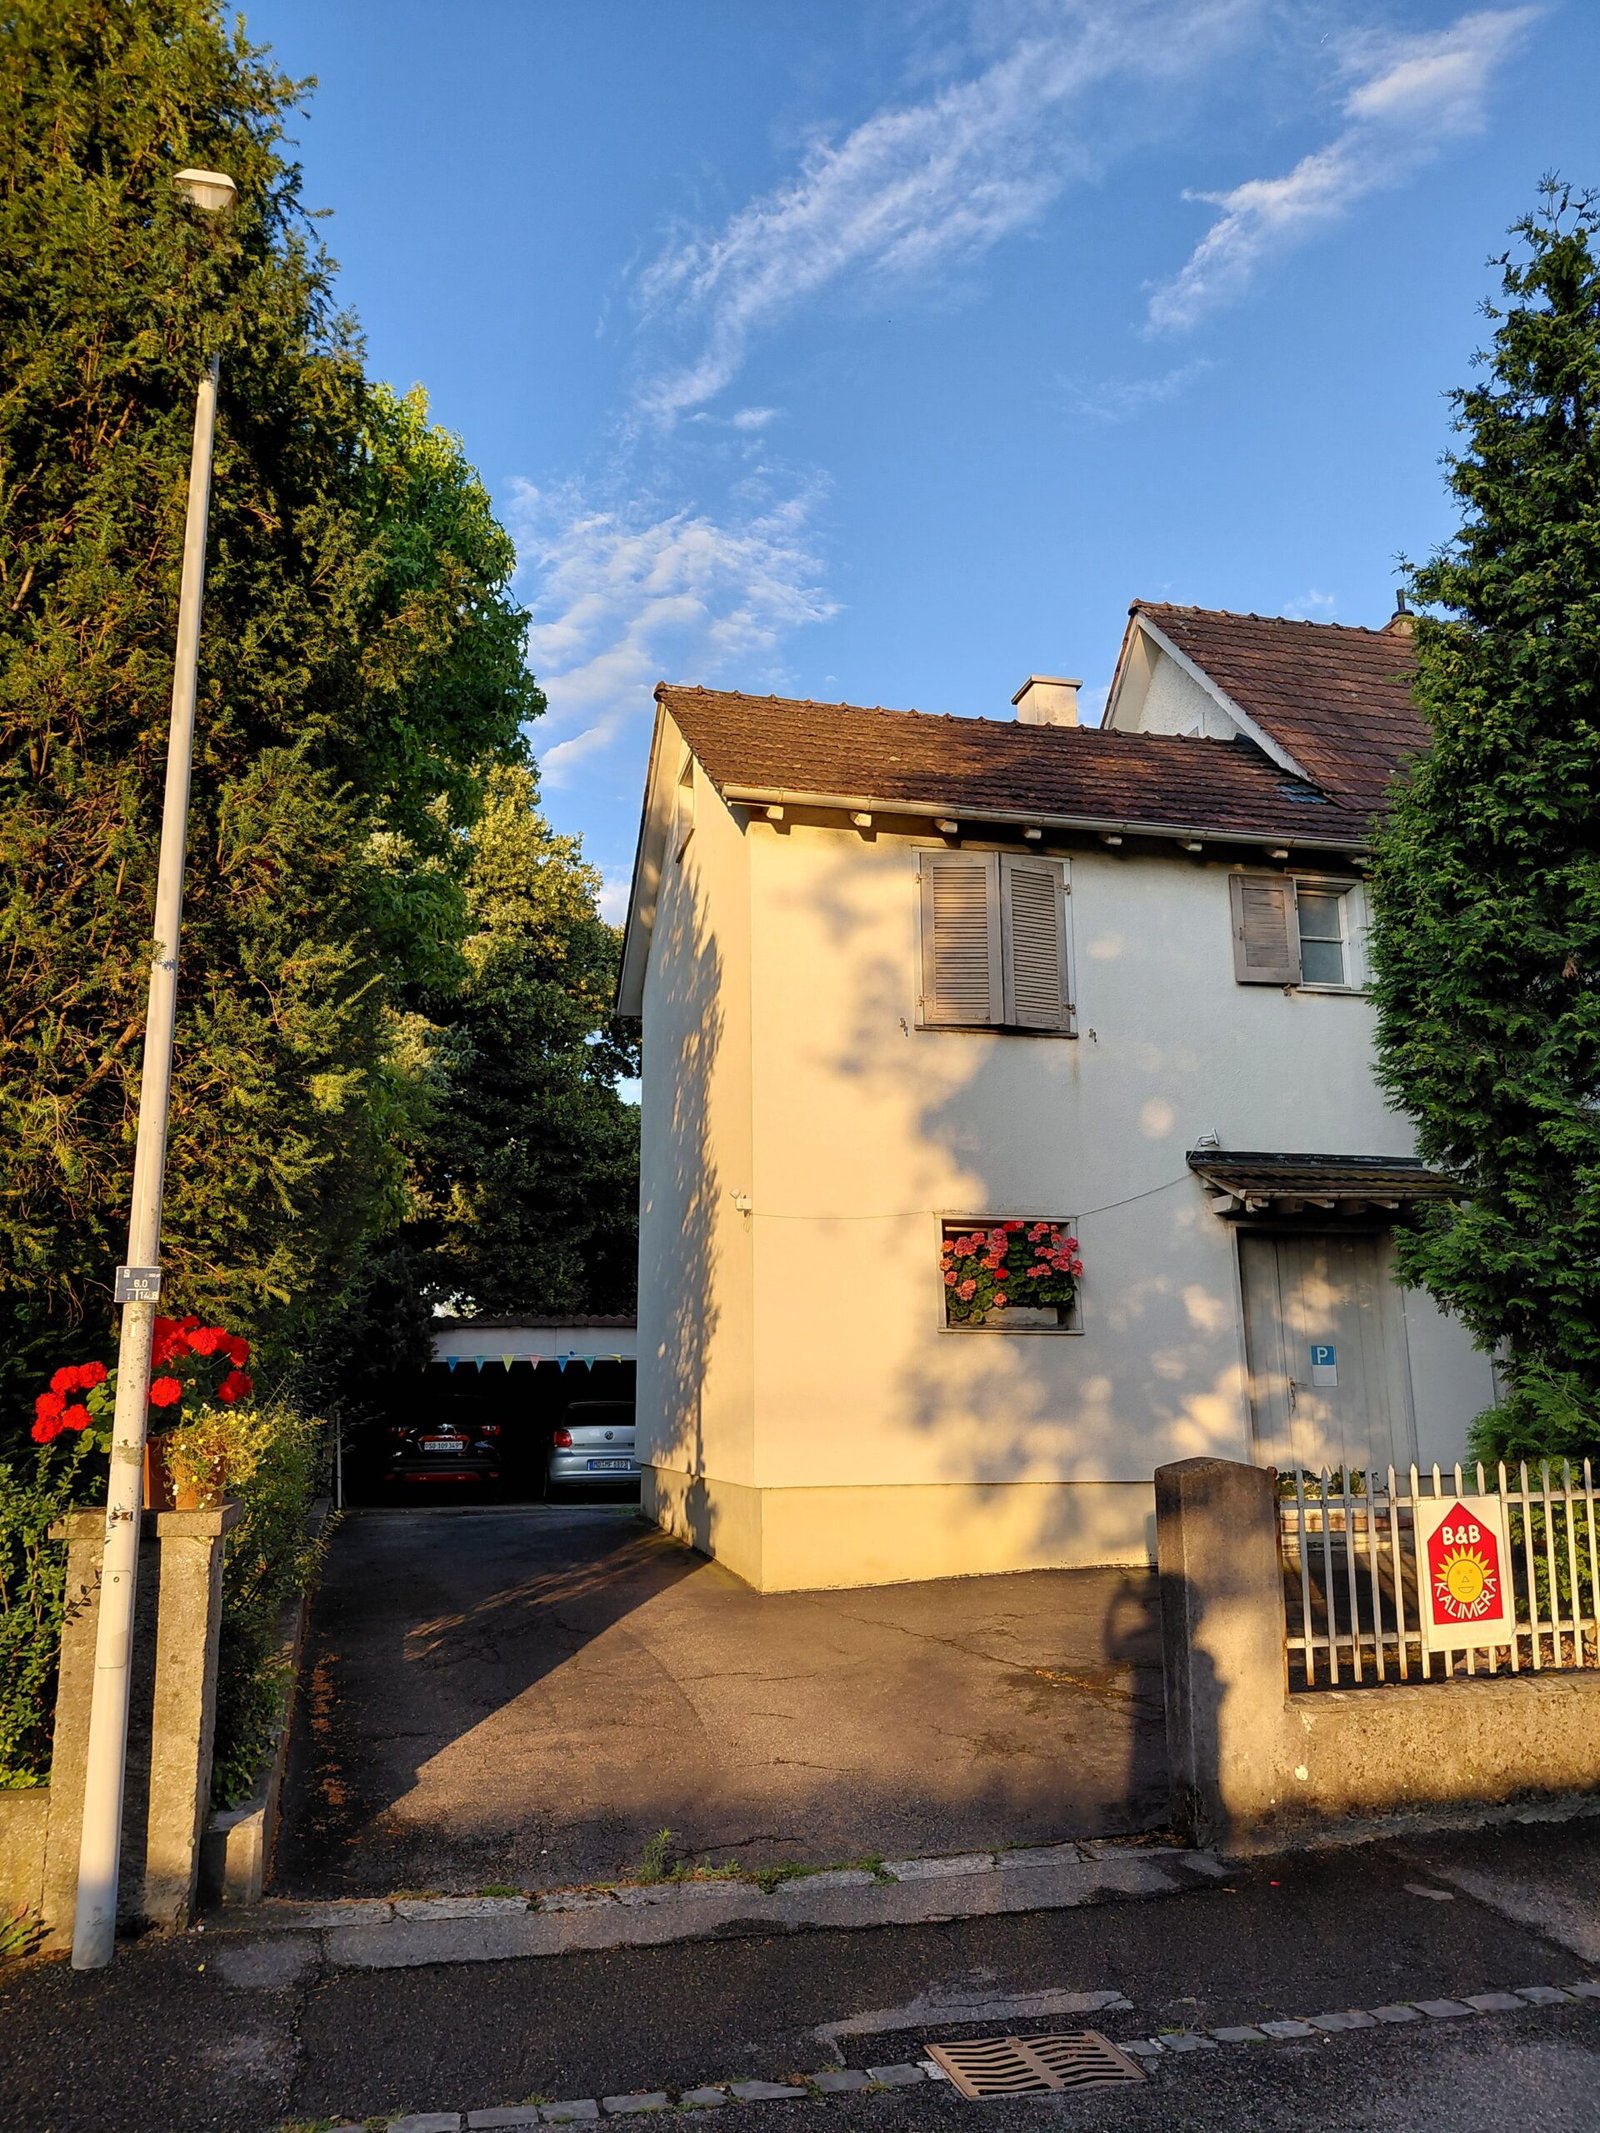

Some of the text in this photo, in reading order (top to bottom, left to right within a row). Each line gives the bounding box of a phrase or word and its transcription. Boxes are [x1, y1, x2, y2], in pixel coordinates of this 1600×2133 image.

[134, 1279, 148, 1288] 6.0
[1316, 1347, 1328, 1364] P
[1441, 1525, 1481, 1546] B&B
[1434, 1577, 1497, 1620] KALIMERA
